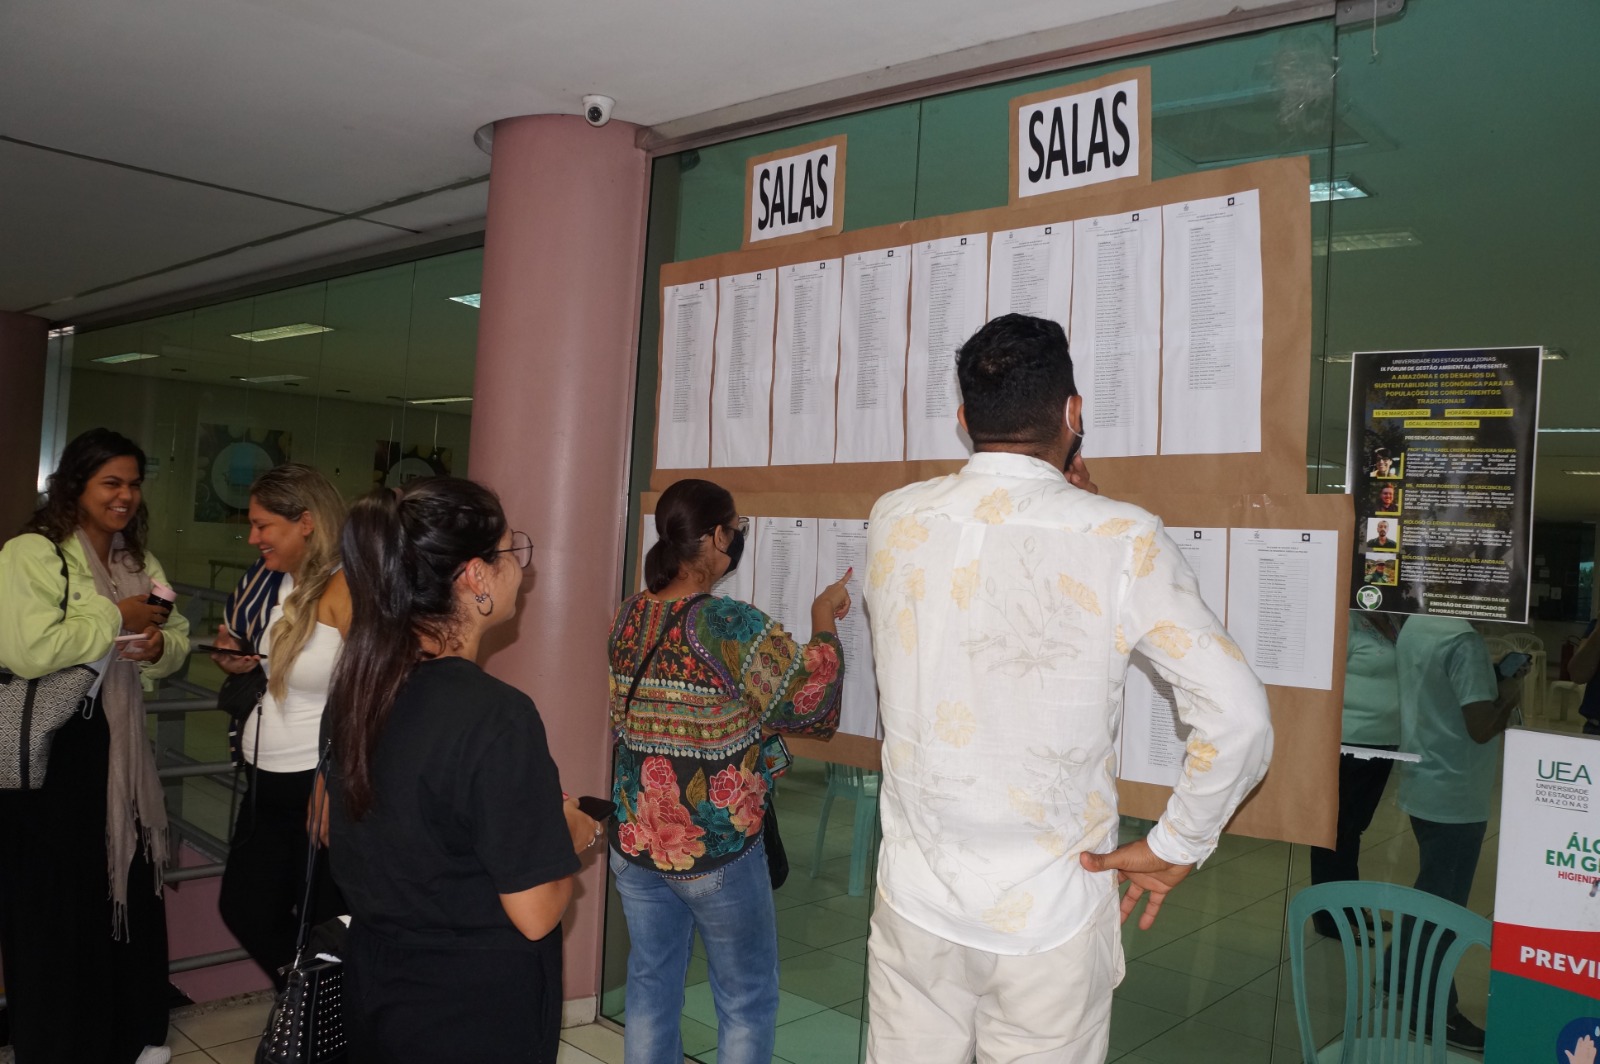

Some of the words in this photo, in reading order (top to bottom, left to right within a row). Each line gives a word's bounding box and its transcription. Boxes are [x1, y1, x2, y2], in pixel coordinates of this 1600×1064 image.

[1028, 90, 1130, 183] SALAS
[757, 153, 829, 231] SALAS
[1538, 760, 1592, 785] UEA
[1536, 782, 1589, 795] UNIVERSIDADE
[1548, 791, 1576, 800] ESTADO
[1535, 797, 1588, 809] AMAZONAS
[1546, 850, 1575, 868] EM
[1581, 856, 1600, 873] G
[1520, 946, 1600, 979] PREVI
